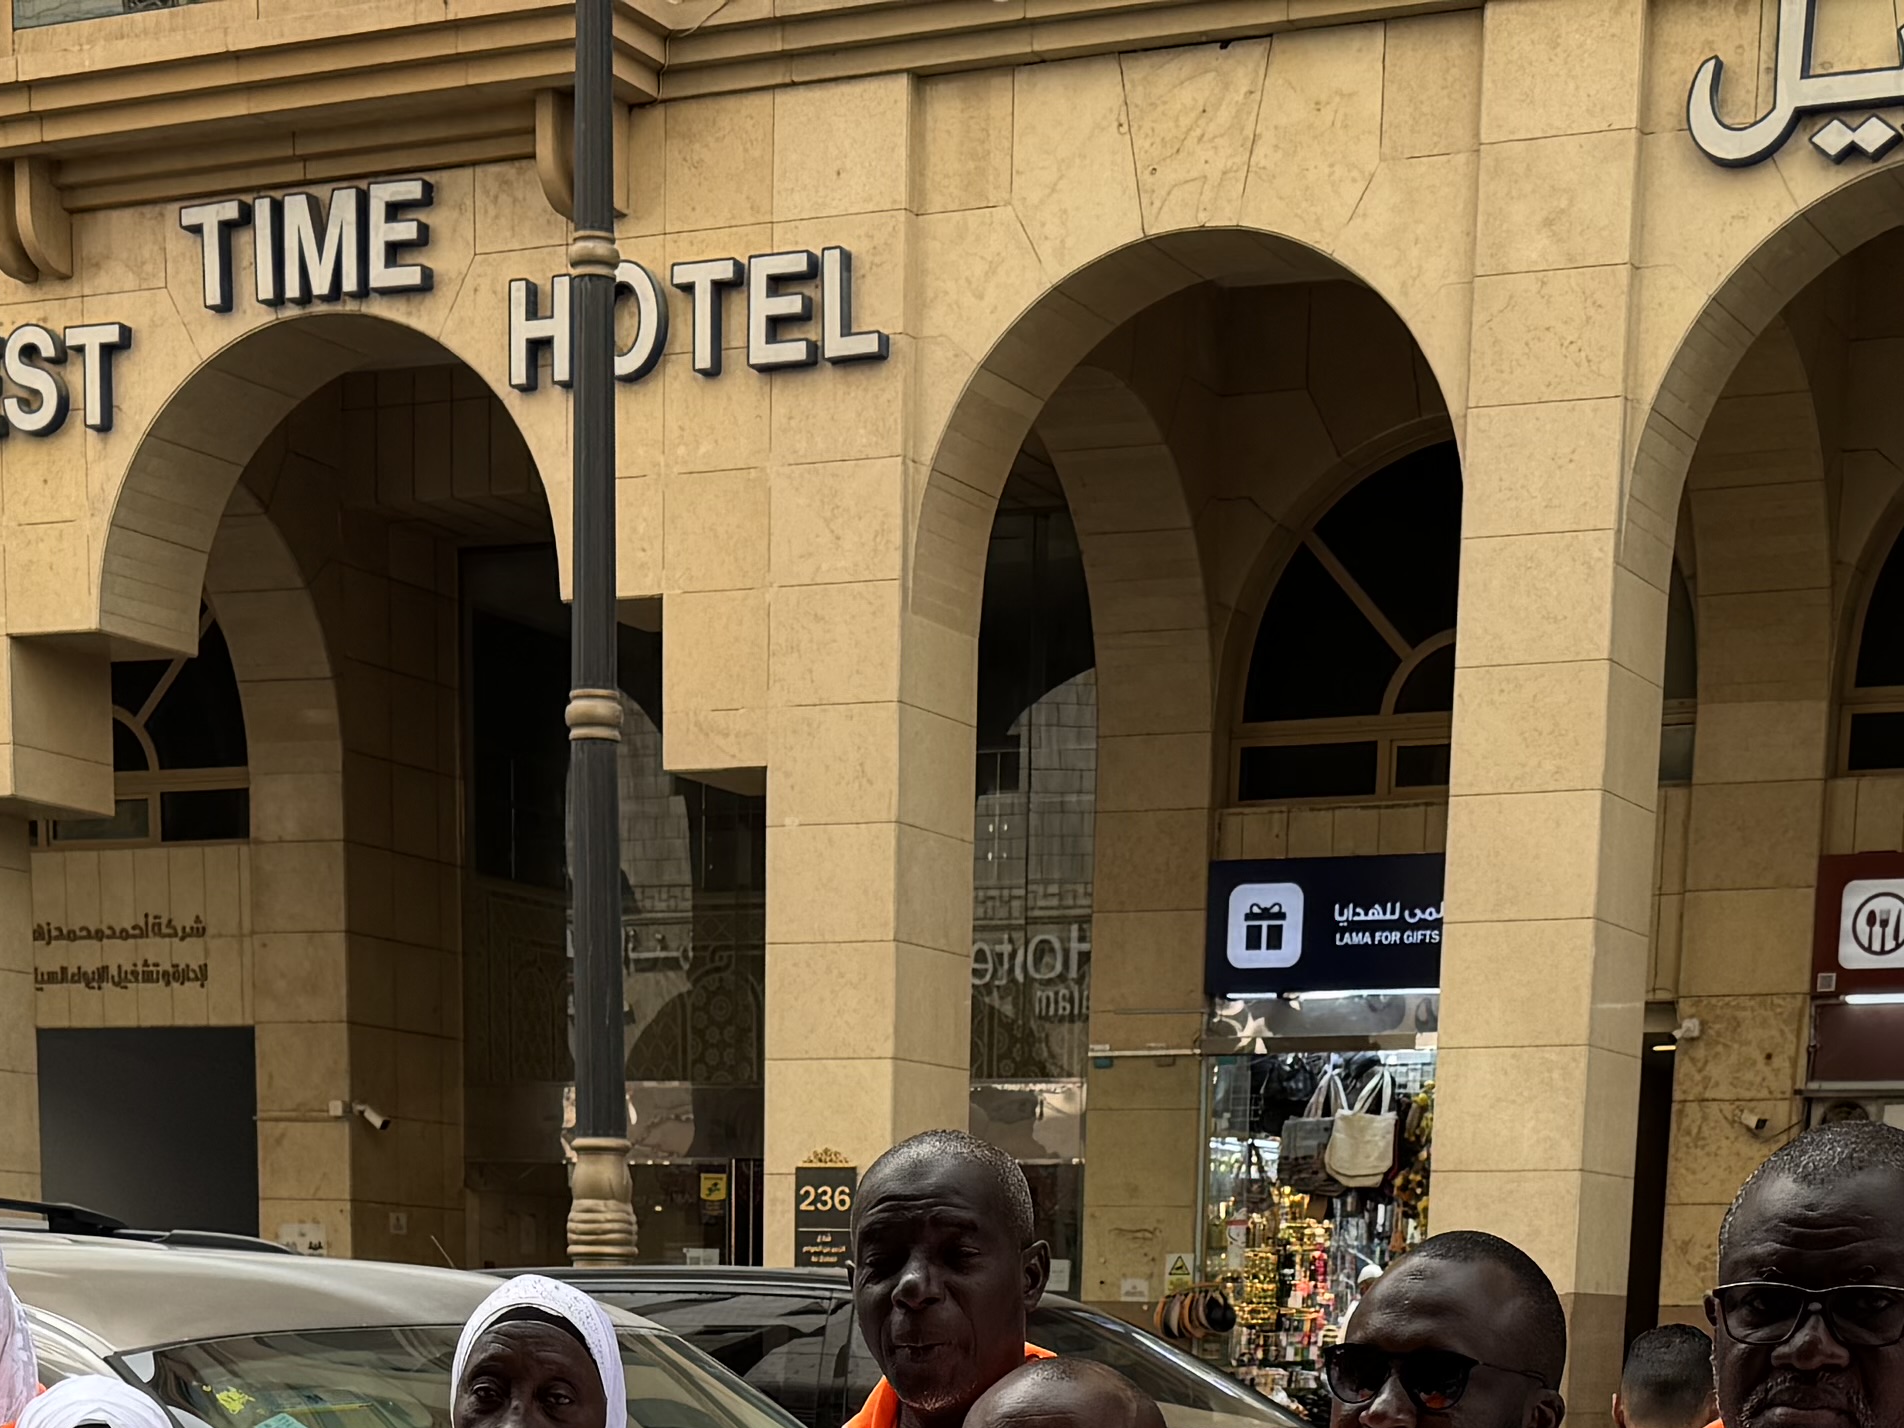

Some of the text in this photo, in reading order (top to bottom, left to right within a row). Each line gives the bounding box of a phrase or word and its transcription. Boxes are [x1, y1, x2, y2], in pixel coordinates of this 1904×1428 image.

[180, 178, 434, 313] TIME
[508, 245, 889, 393] HOTEL
[1334, 901, 1401, 926] للهدايا
[151, 914, 207, 942] شركة
[1336, 930, 1441, 946] LAMA FOR GIFTS
[799, 1185, 851, 1211] 236
